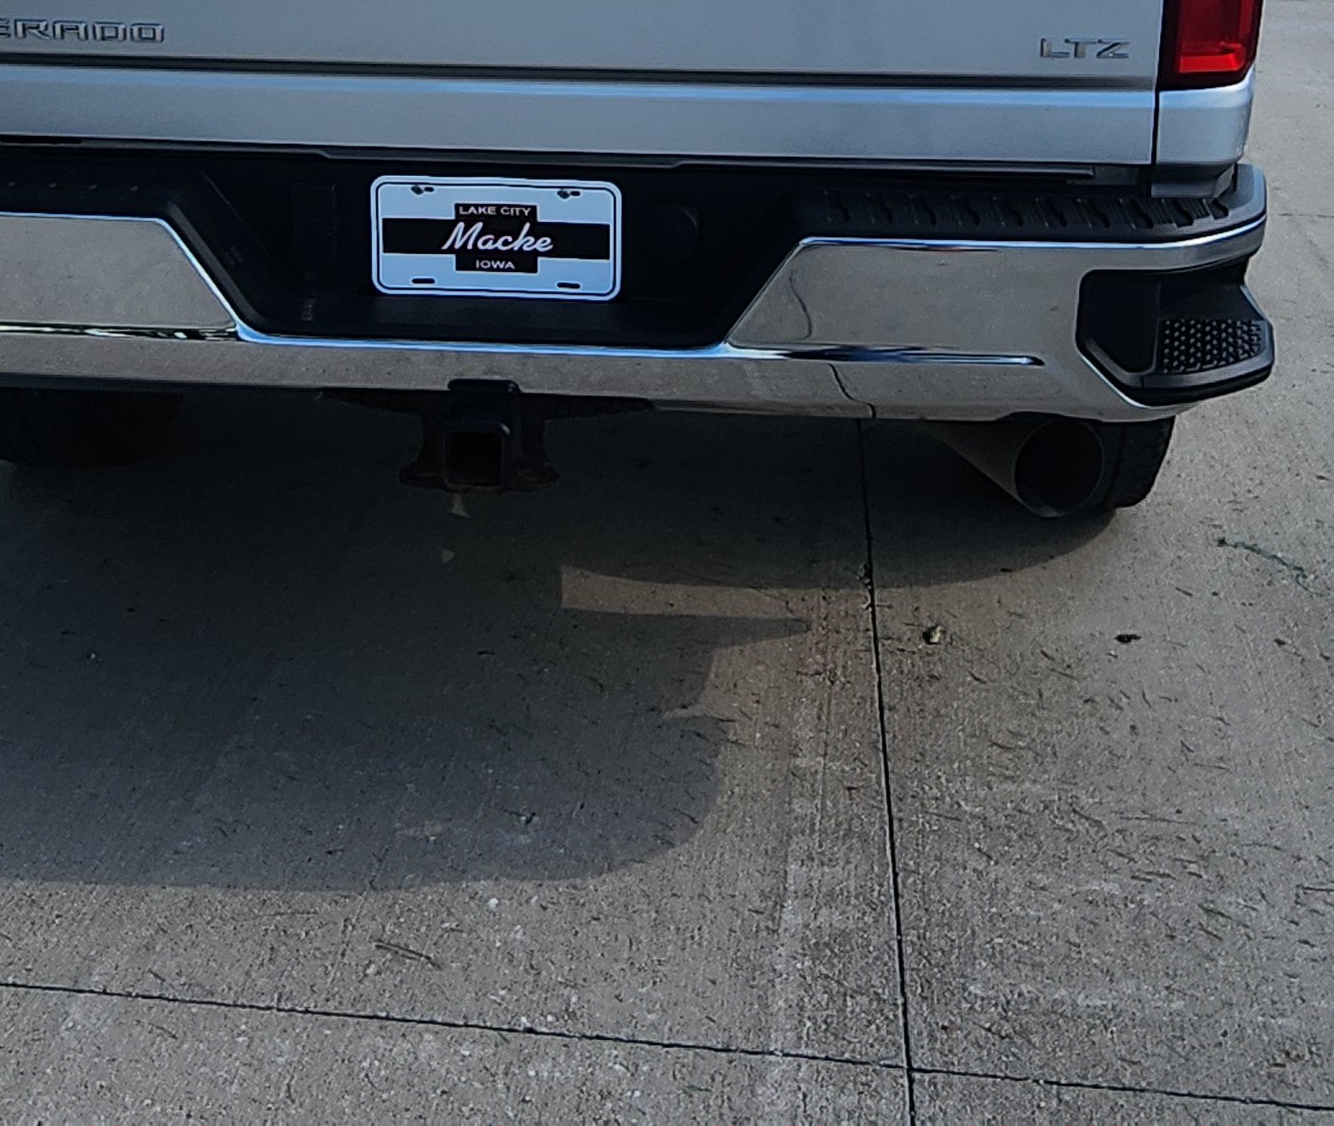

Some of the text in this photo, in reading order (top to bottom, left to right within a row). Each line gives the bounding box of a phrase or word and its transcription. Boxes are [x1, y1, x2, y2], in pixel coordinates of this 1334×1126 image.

[1039, 37, 1130, 59] LTZ
[459, 205, 532, 217] LAKE CITY
[441, 221, 554, 253] Macke
[475, 259, 516, 270] IOWA
